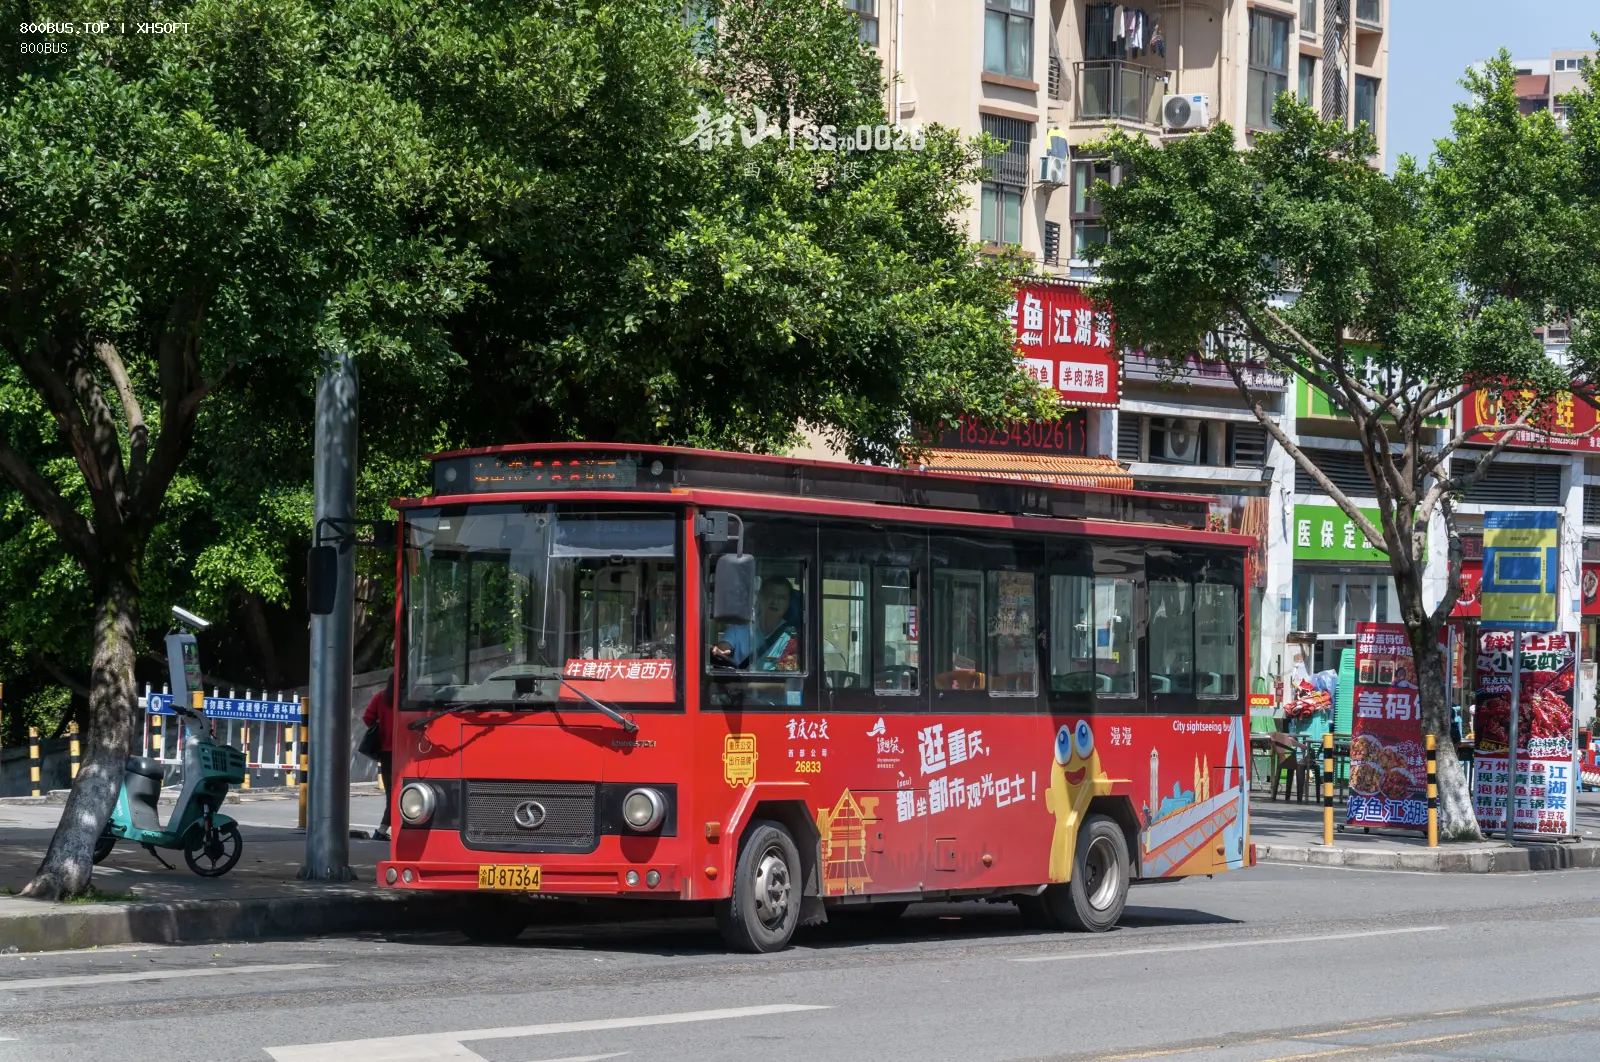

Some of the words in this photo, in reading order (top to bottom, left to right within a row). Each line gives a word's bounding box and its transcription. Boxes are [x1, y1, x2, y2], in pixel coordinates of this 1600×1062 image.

[1062, 367, 1104, 388] 羊肉汤锅
[786, 718, 829, 740] 重庆公交
[1173, 720, 1186, 734] City
[1186, 720, 1222, 735] sightseeing
[795, 760, 822, 773] 26833
[1547, 765, 1567, 810] 江湖菜
